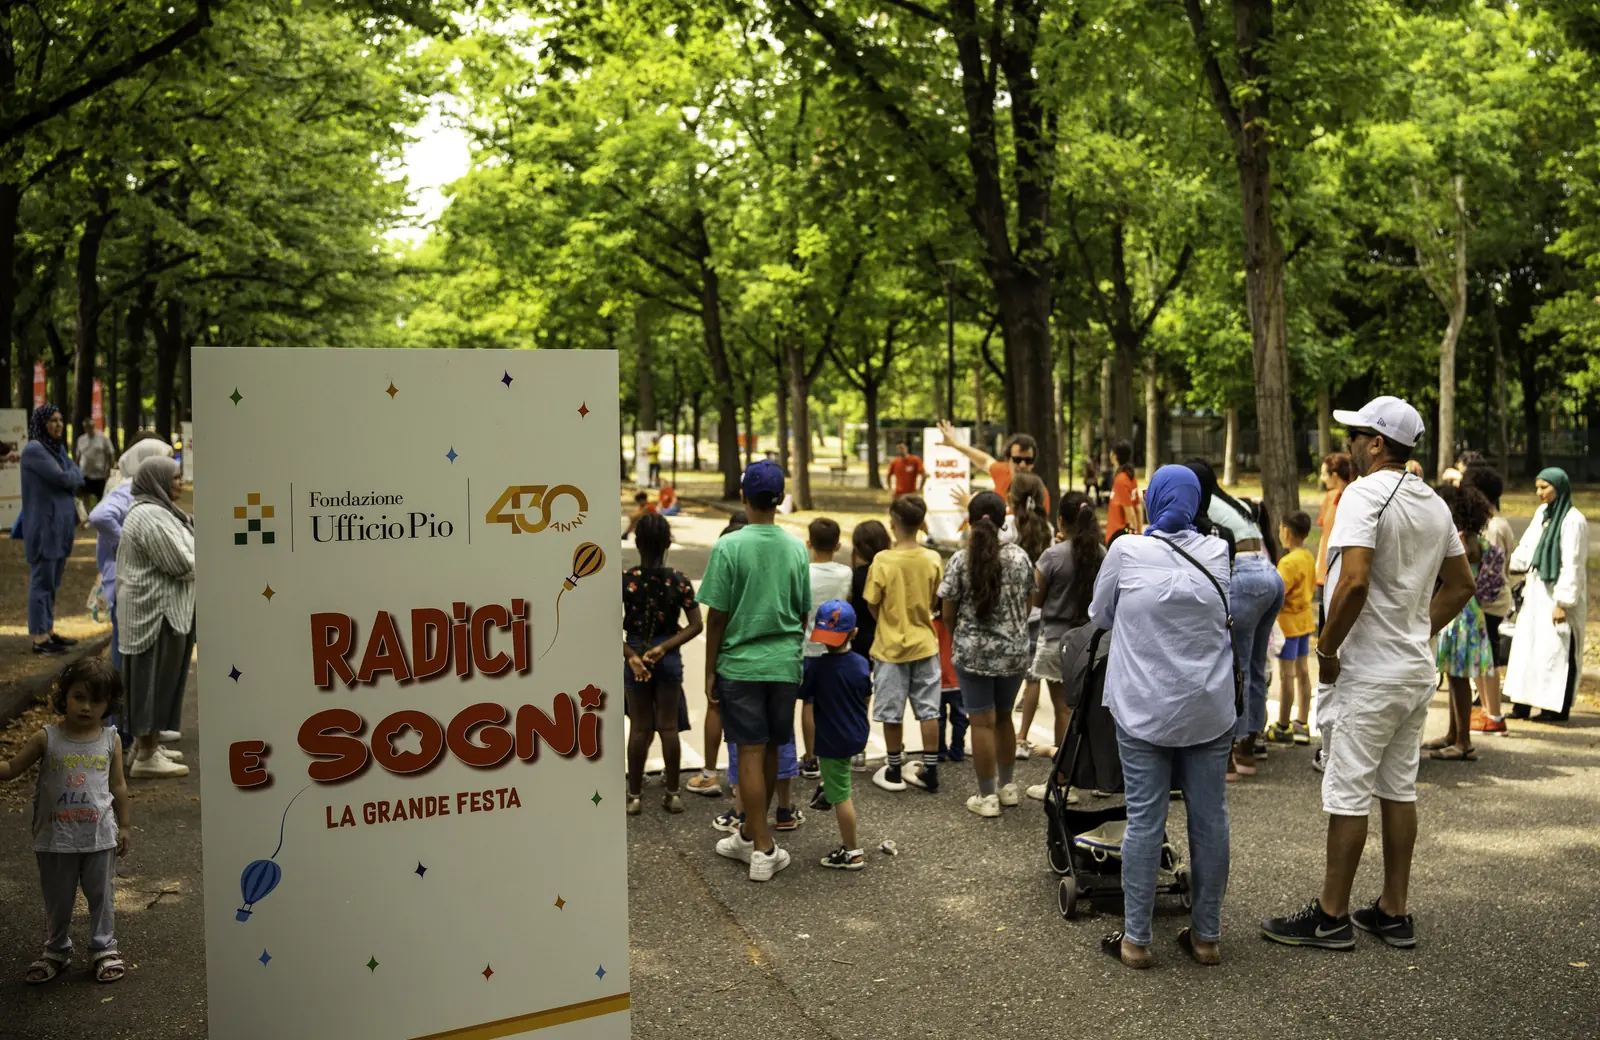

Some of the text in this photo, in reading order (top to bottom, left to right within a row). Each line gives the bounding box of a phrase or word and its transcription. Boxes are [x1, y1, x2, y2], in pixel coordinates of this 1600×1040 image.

[309, 491, 403, 507] Fondazione
[486, 484, 588, 534] 430
[310, 512, 454, 543] Ufficio Pio
[550, 513, 587, 532] ANNI
[51, 754, 109, 771] LOVE
[228, 740, 268, 787] E
[67, 773, 85, 787] IS
[57, 791, 90, 805] ALL
[326, 787, 522, 829] LA GRANDE FESTA
